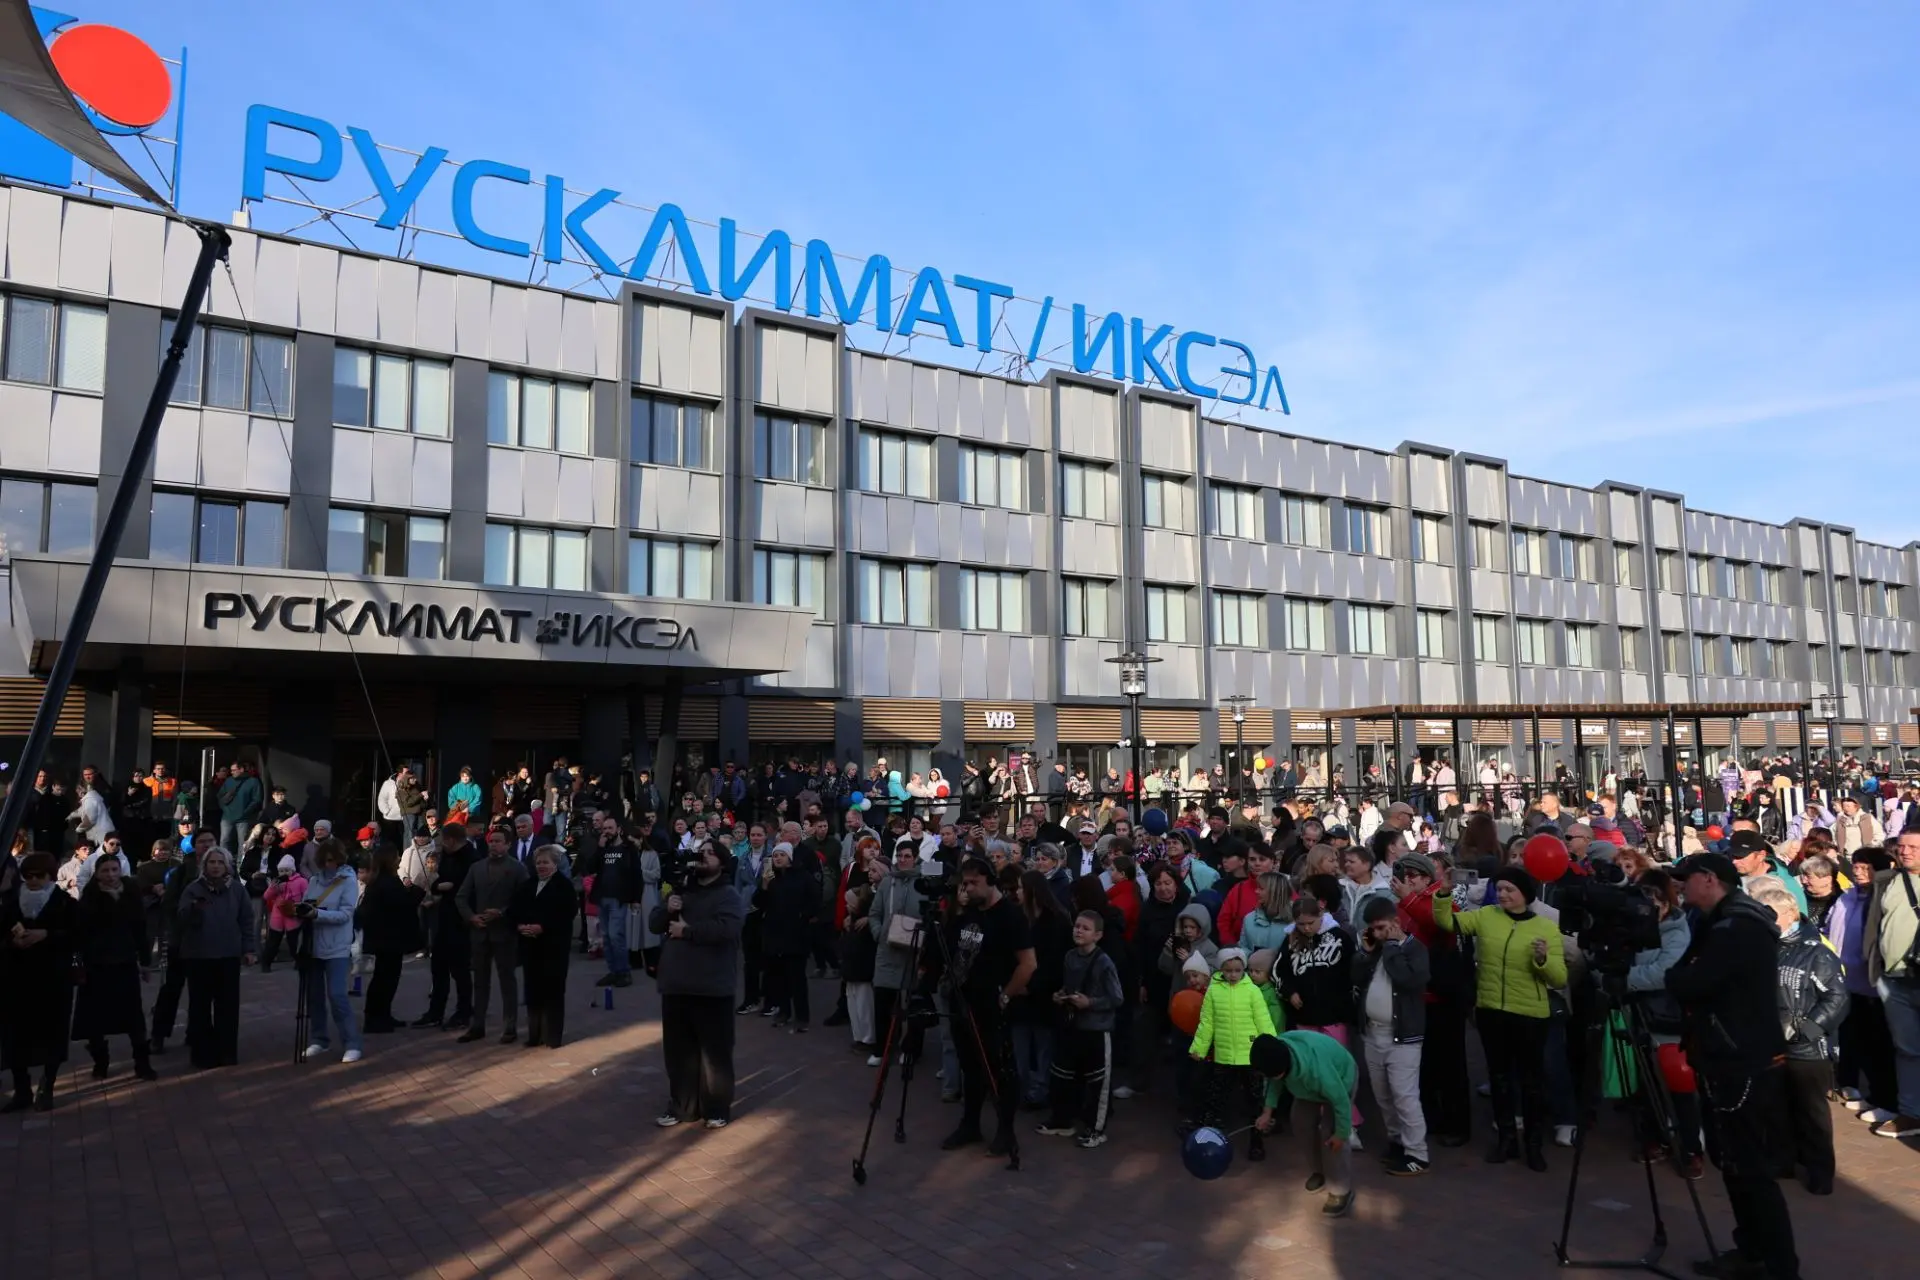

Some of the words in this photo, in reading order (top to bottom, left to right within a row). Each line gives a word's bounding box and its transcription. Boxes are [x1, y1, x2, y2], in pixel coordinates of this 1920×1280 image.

[243, 104, 1013, 352] РУСКЛИМАТ
[203, 592, 532, 643] РУСКЛИМАТ
[984, 711, 1016, 729] WB
